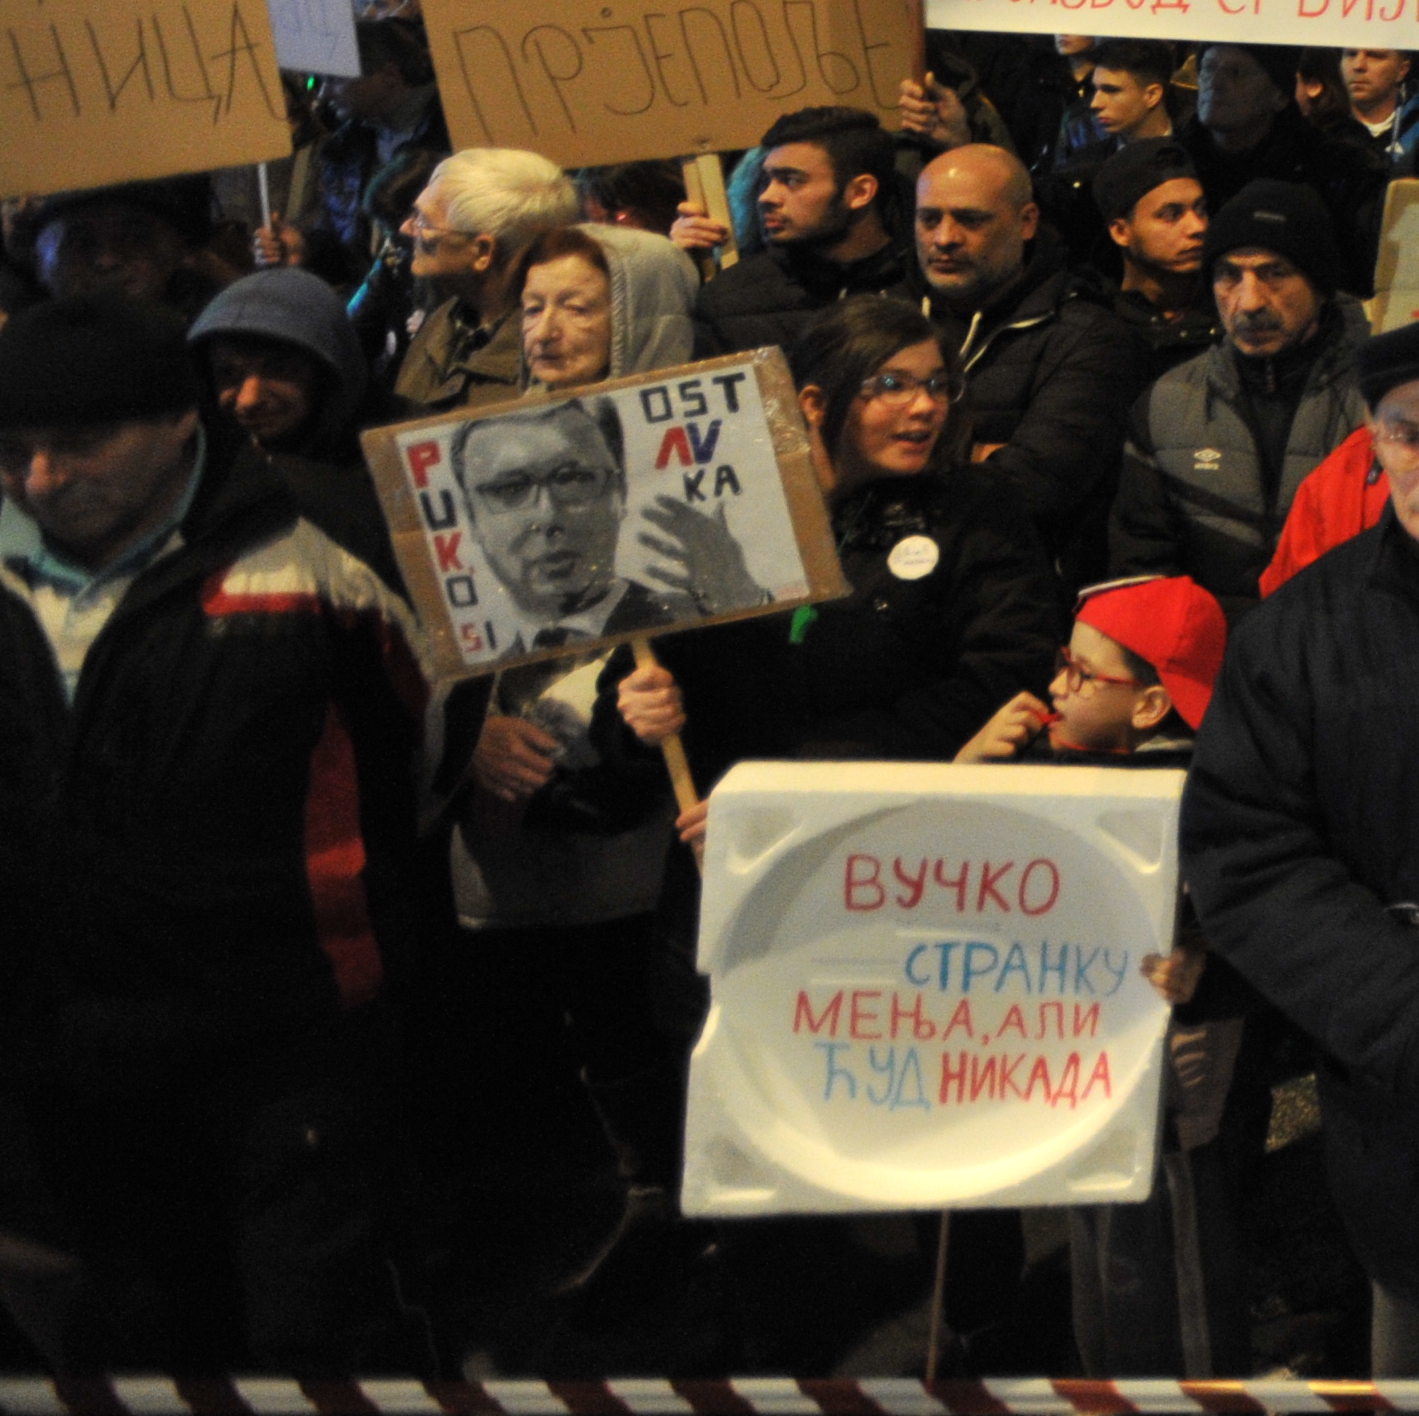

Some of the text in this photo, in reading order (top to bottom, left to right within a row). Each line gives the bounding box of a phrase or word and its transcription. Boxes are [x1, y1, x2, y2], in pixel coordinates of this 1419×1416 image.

[638, 371, 746, 424] OST
[683, 464, 743, 504] KA
[842, 852, 1062, 917] ВУЧКО
[905, 940, 1130, 997] СТРАНКУ
[814, 1041, 1114, 1113] ЋУД НИКАДА
